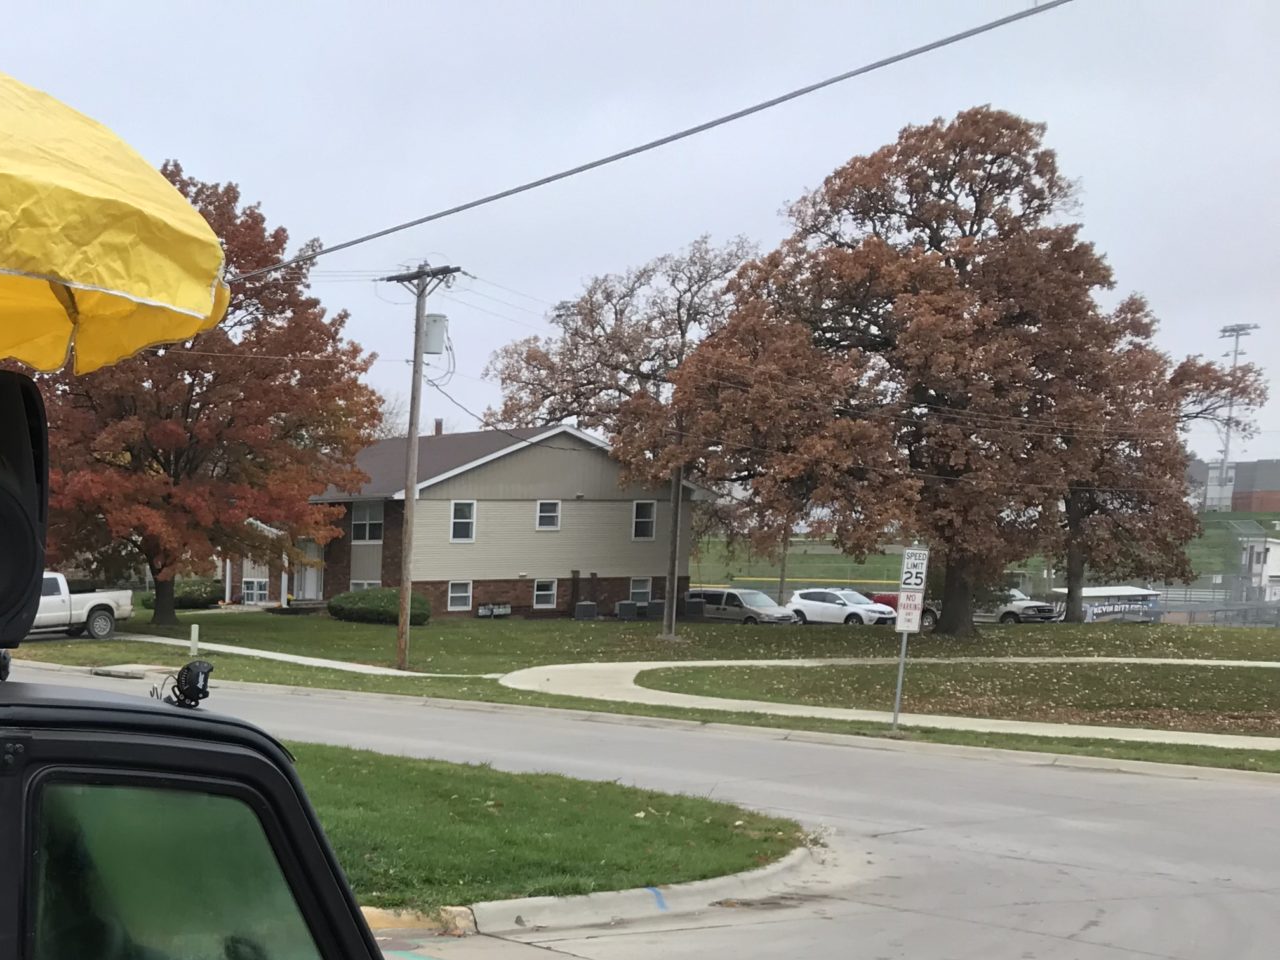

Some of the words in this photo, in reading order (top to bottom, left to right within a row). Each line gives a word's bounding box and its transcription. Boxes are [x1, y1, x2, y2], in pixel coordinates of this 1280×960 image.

[906, 551, 927, 561] SPEED
[906, 562, 924, 570] LIMIT
[902, 570, 924, 586] 25
[905, 594, 917, 602] NO
